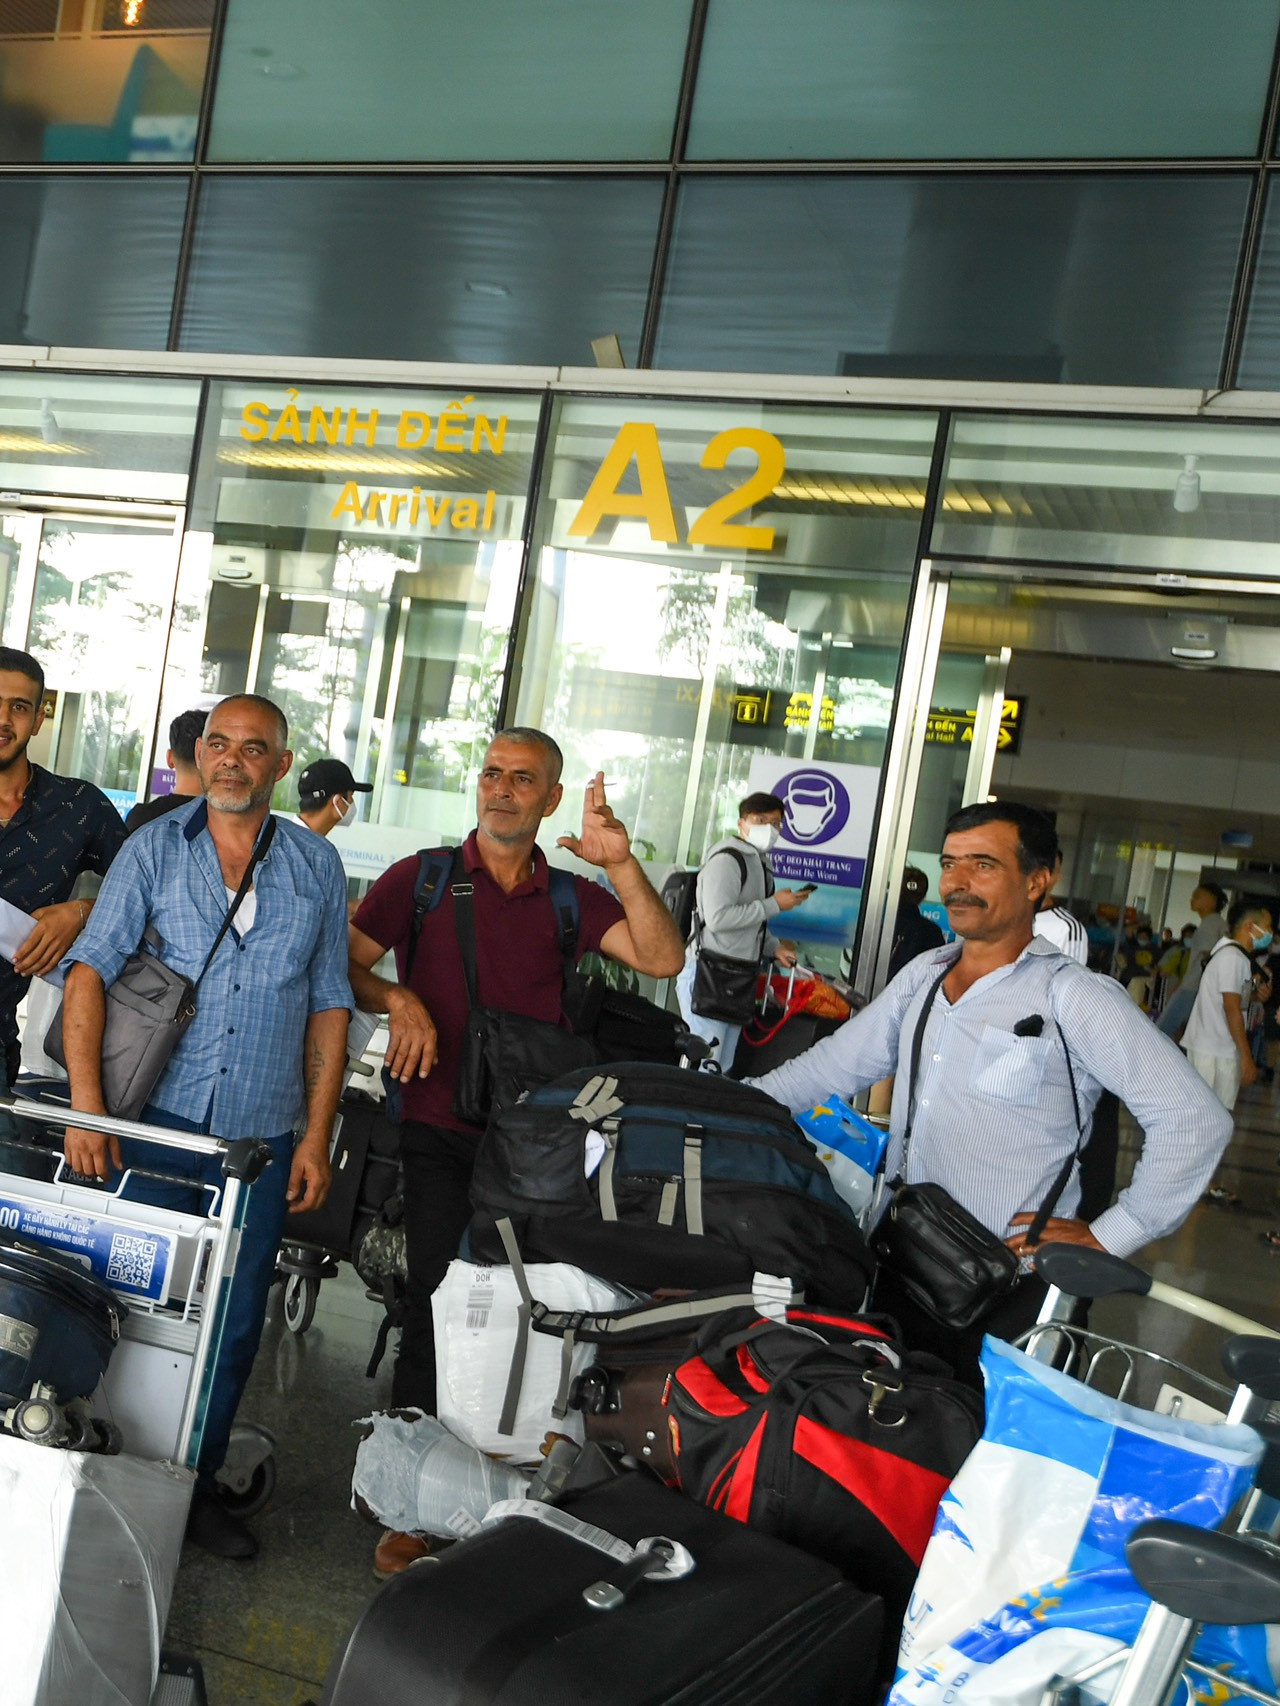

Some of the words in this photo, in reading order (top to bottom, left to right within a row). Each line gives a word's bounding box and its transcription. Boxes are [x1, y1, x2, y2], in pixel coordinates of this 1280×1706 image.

[239, 387, 379, 448] SẢNH
[397, 394, 508, 455] ĐẾN
[566, 421, 786, 550] A2
[330, 480, 496, 530] Arrival
[782, 866, 802, 876] Must
[817, 870, 838, 881] Worn
[826, 860, 851, 872] TRANG
[475, 1273, 491, 1282] DOH
